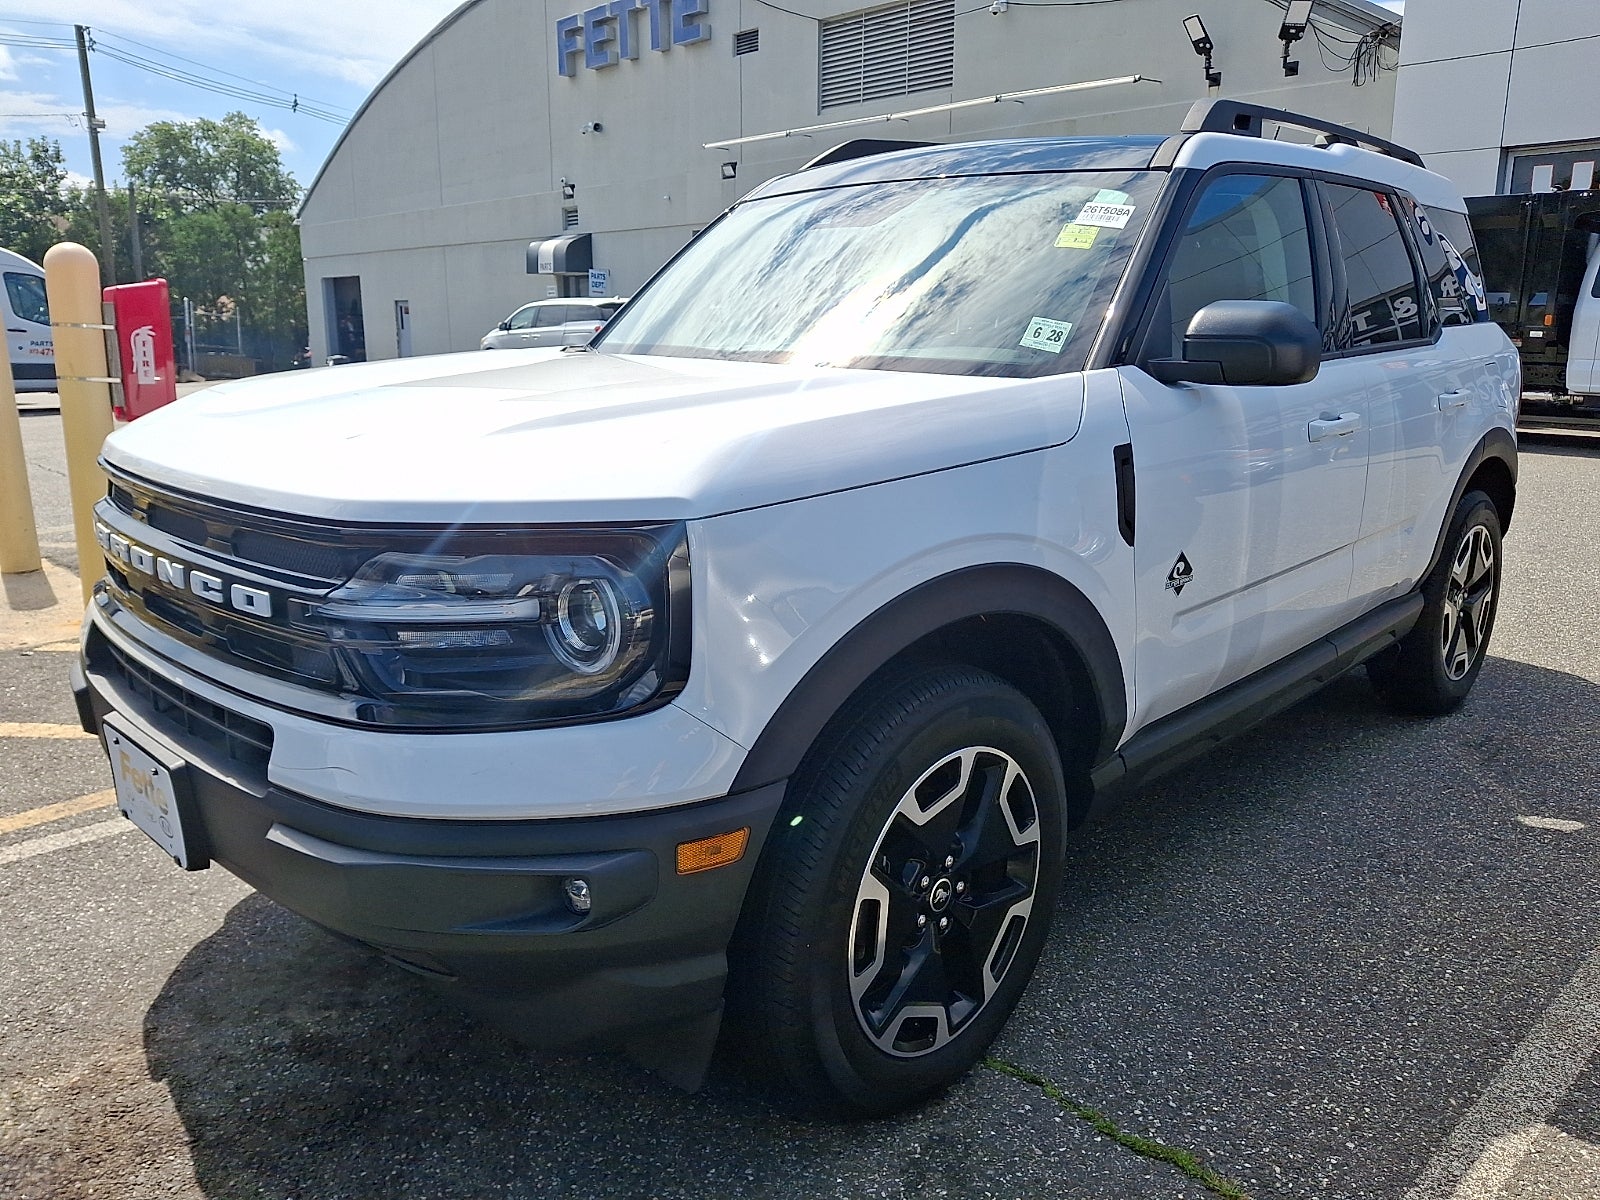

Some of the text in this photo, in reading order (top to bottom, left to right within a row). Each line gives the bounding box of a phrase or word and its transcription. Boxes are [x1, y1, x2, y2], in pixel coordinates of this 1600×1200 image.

[555, 0, 711, 77] FETTE
[1083, 205, 1130, 217] 26T508A
[590, 272, 606, 281] PARTS
[1032, 326, 1043, 339] 6
[1046, 329, 1064, 343] 28
[142, 340, 150, 377] FIRE
[95, 522, 272, 618] BRONCO
